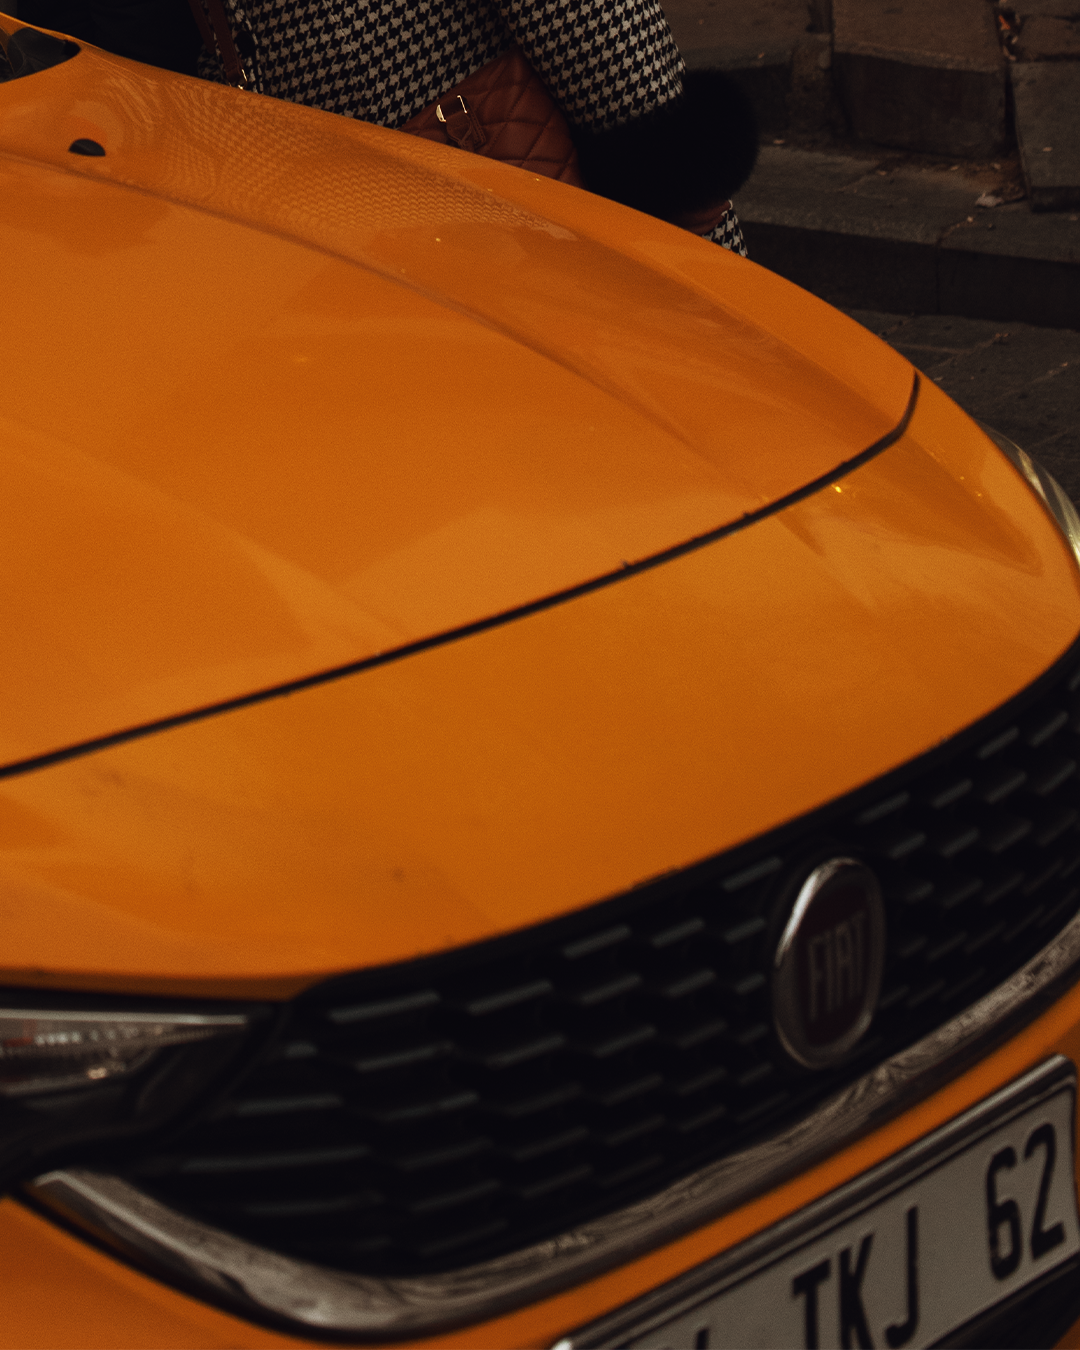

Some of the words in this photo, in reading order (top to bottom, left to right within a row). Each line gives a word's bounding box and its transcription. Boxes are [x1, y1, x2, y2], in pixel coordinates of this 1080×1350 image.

[806, 908, 868, 1024] FIAT
[792, 1205, 920, 1350] TKJ
[986, 1122, 1067, 1282] 62
